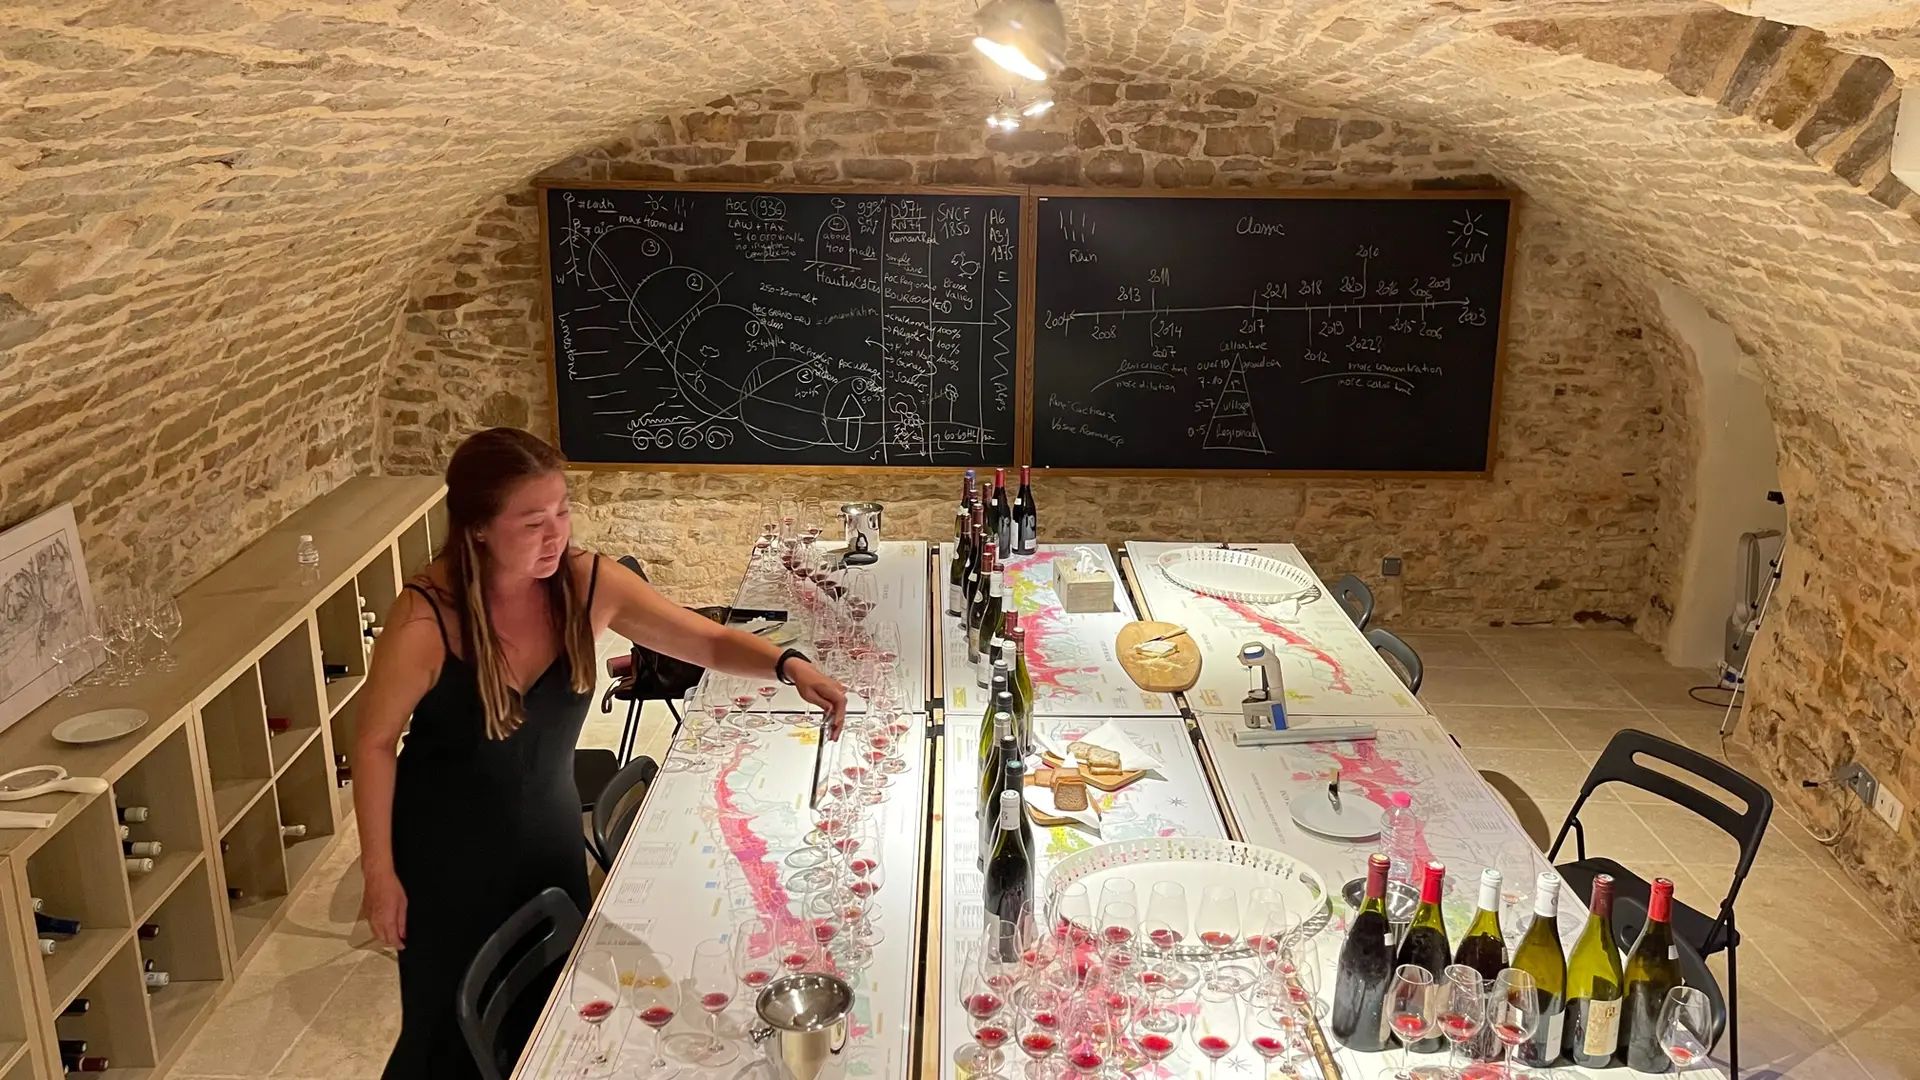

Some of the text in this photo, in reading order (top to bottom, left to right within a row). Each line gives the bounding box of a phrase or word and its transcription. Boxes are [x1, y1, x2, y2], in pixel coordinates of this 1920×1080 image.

[936, 202, 970, 222] SNCF
[989, 207, 1006, 225] A6
[727, 219, 753, 230] LAW
[940, 221, 971, 240] 1850
[1235, 215, 1286, 236] Classic
[1069, 248, 1098, 264] Rain
[555, 272, 565, 285] W
[1117, 285, 1142, 302] 2013
[1298, 279, 1323, 296] 2018
[1091, 324, 1118, 340] 2008
[1153, 320, 1183, 339] 2014
[1239, 318, 1266, 335] 2017
[1303, 348, 1331, 364] 2012
